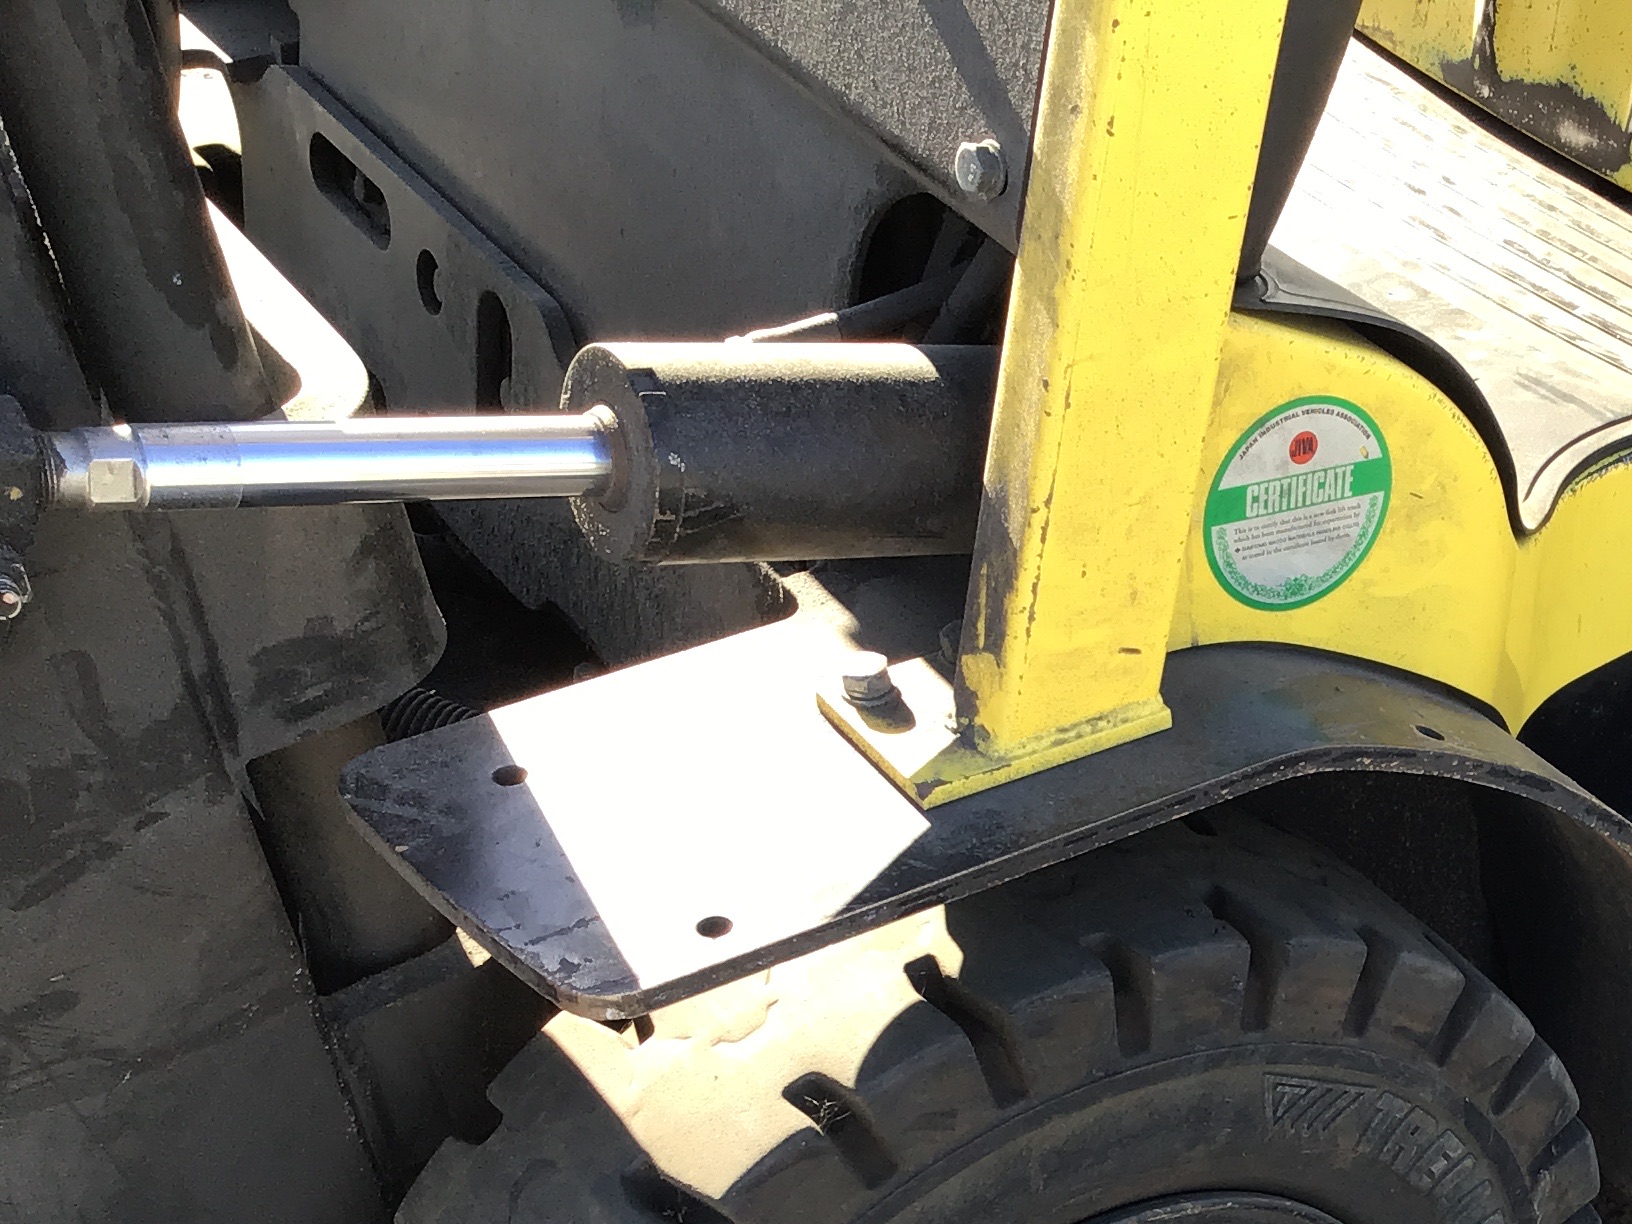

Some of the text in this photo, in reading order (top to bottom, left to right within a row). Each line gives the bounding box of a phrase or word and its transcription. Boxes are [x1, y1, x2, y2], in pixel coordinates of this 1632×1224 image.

[1239, 437, 1259, 460] JAPAN
[1258, 412, 1301, 439] INDUSTRIAL
[1335, 411, 1372, 441] ASSOCIATION
[1246, 464, 1355, 518] CERTIFICATE
